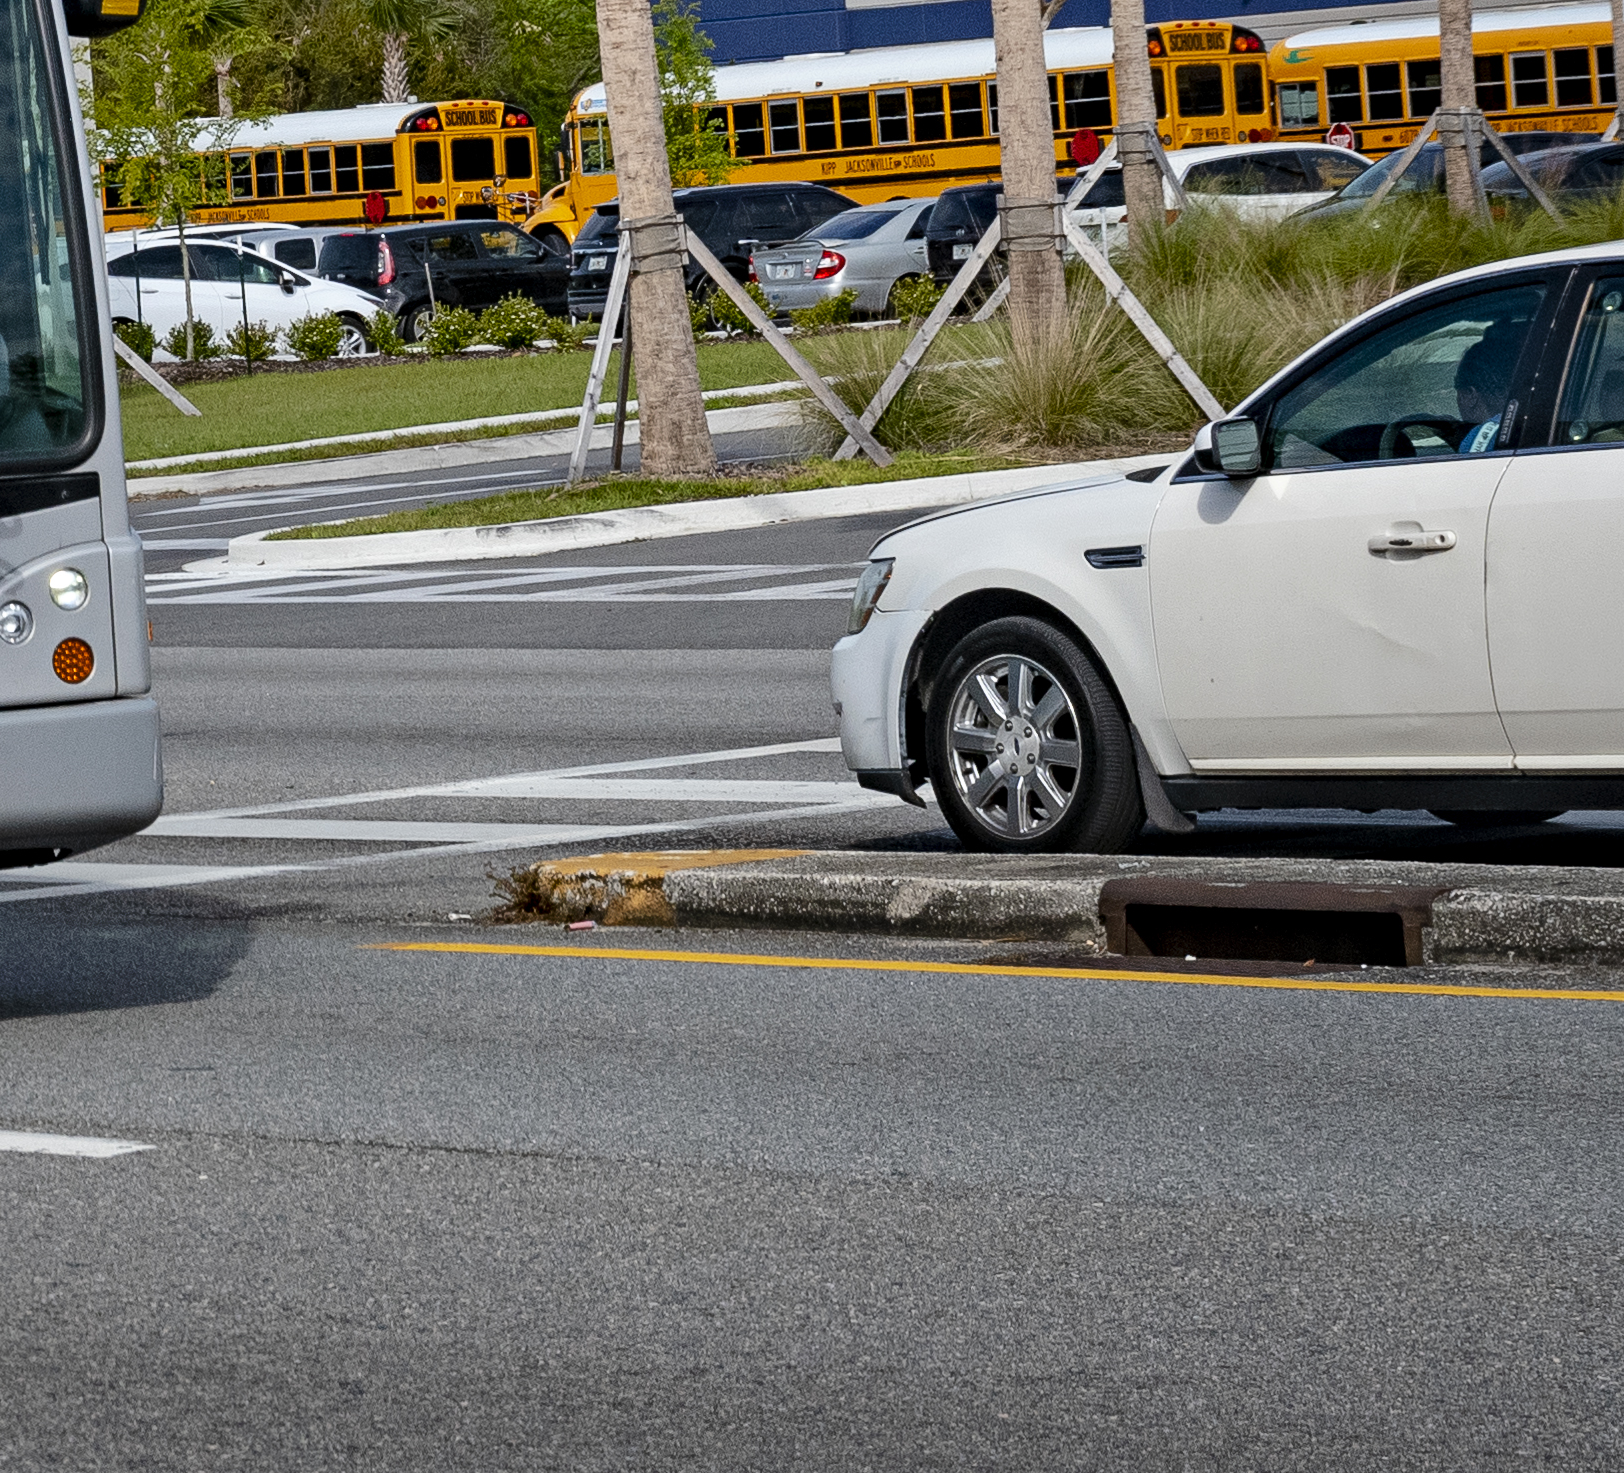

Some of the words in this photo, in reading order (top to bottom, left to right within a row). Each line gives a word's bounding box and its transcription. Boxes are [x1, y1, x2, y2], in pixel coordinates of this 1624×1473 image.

[1170, 32, 1205, 52] SCHOOL
[1206, 32, 1225, 50] BUS
[445, 110, 477, 126] SCHOOL
[479, 109, 496, 125] BUS
[821, 161, 837, 176] KIPP
[844, 156, 894, 174] JACKSONVILLE
[903, 153, 936, 169] SCHOOLS
[247, 208, 270, 221] SCHOOLS
